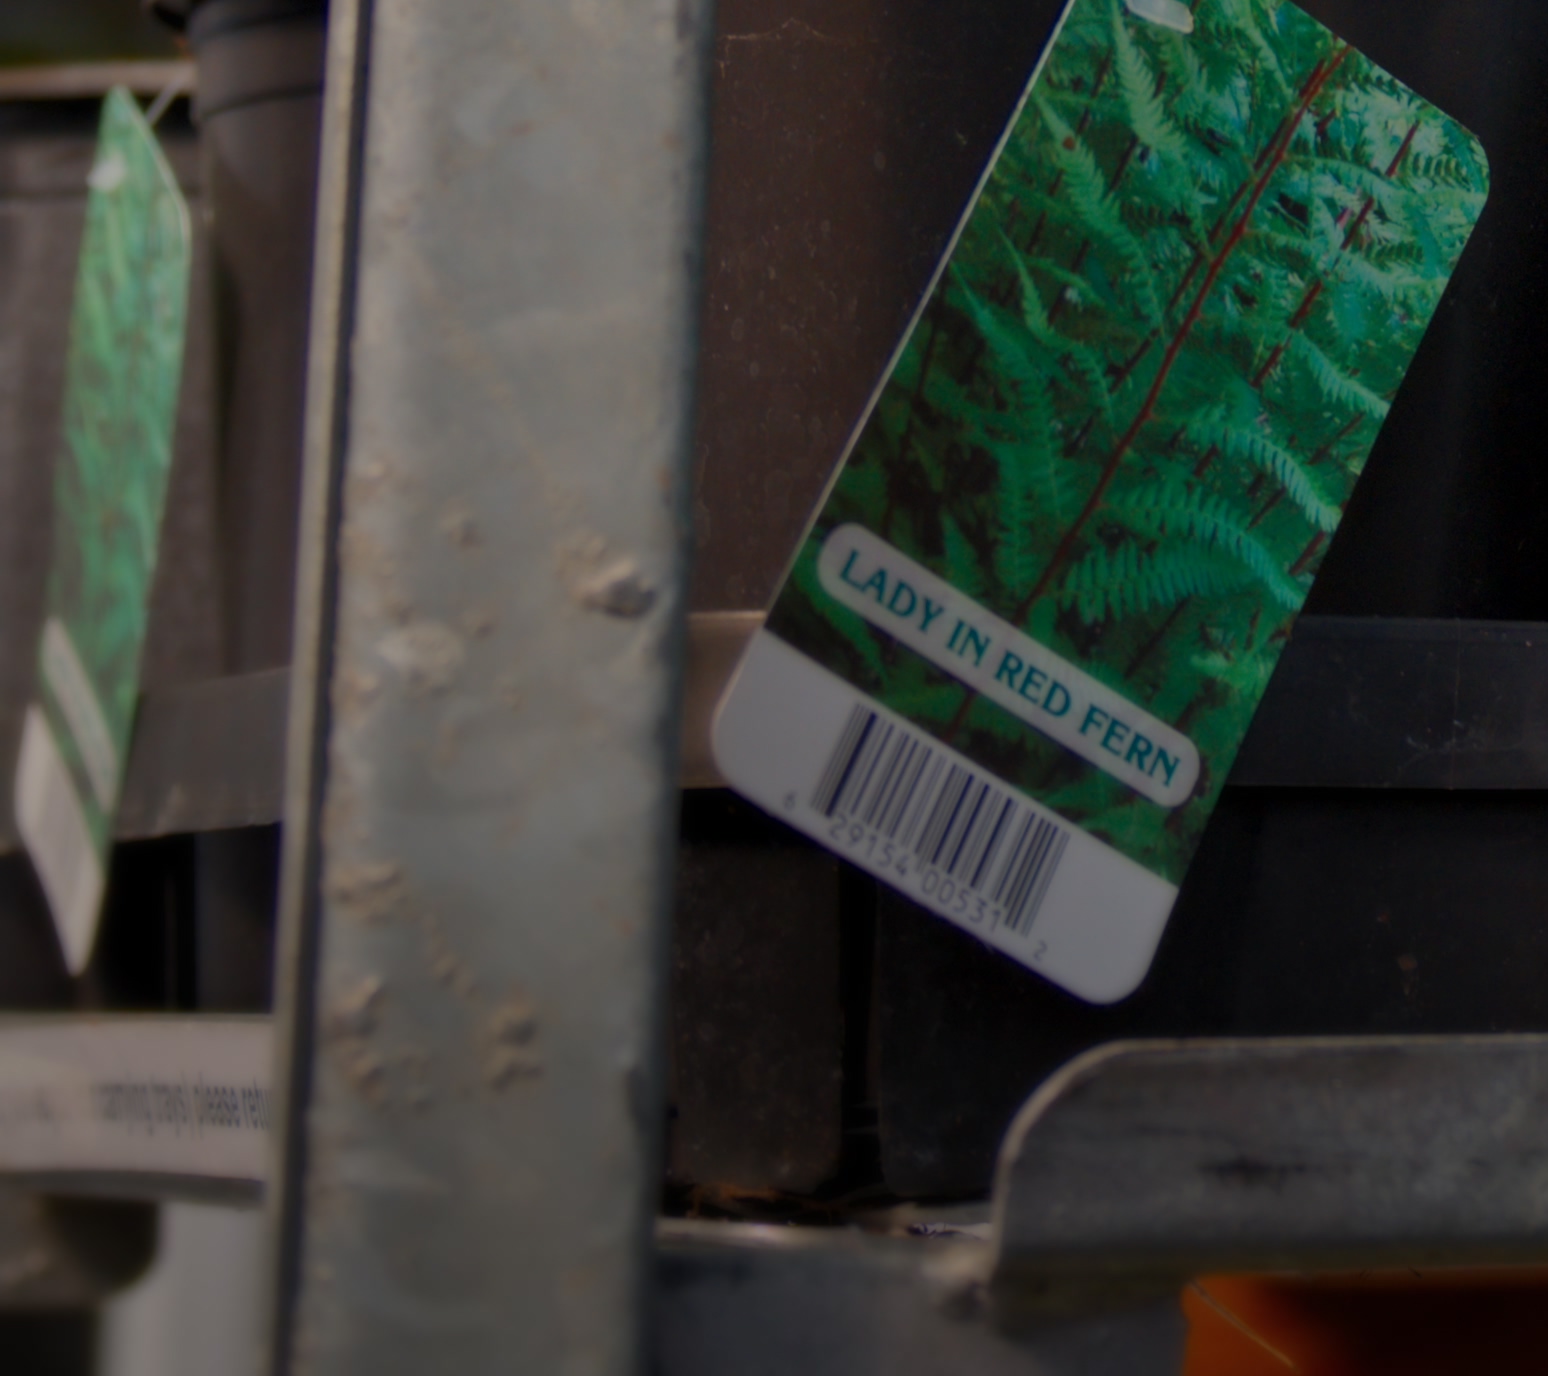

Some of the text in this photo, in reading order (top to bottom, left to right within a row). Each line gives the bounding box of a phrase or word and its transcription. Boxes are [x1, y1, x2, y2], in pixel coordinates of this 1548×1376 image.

[840, 549, 1180, 788] LADY IN RED FERN
[829, 815, 907, 877] 29154
[921, 873, 1002, 933] 00531
[1032, 941, 1047, 960] 2
